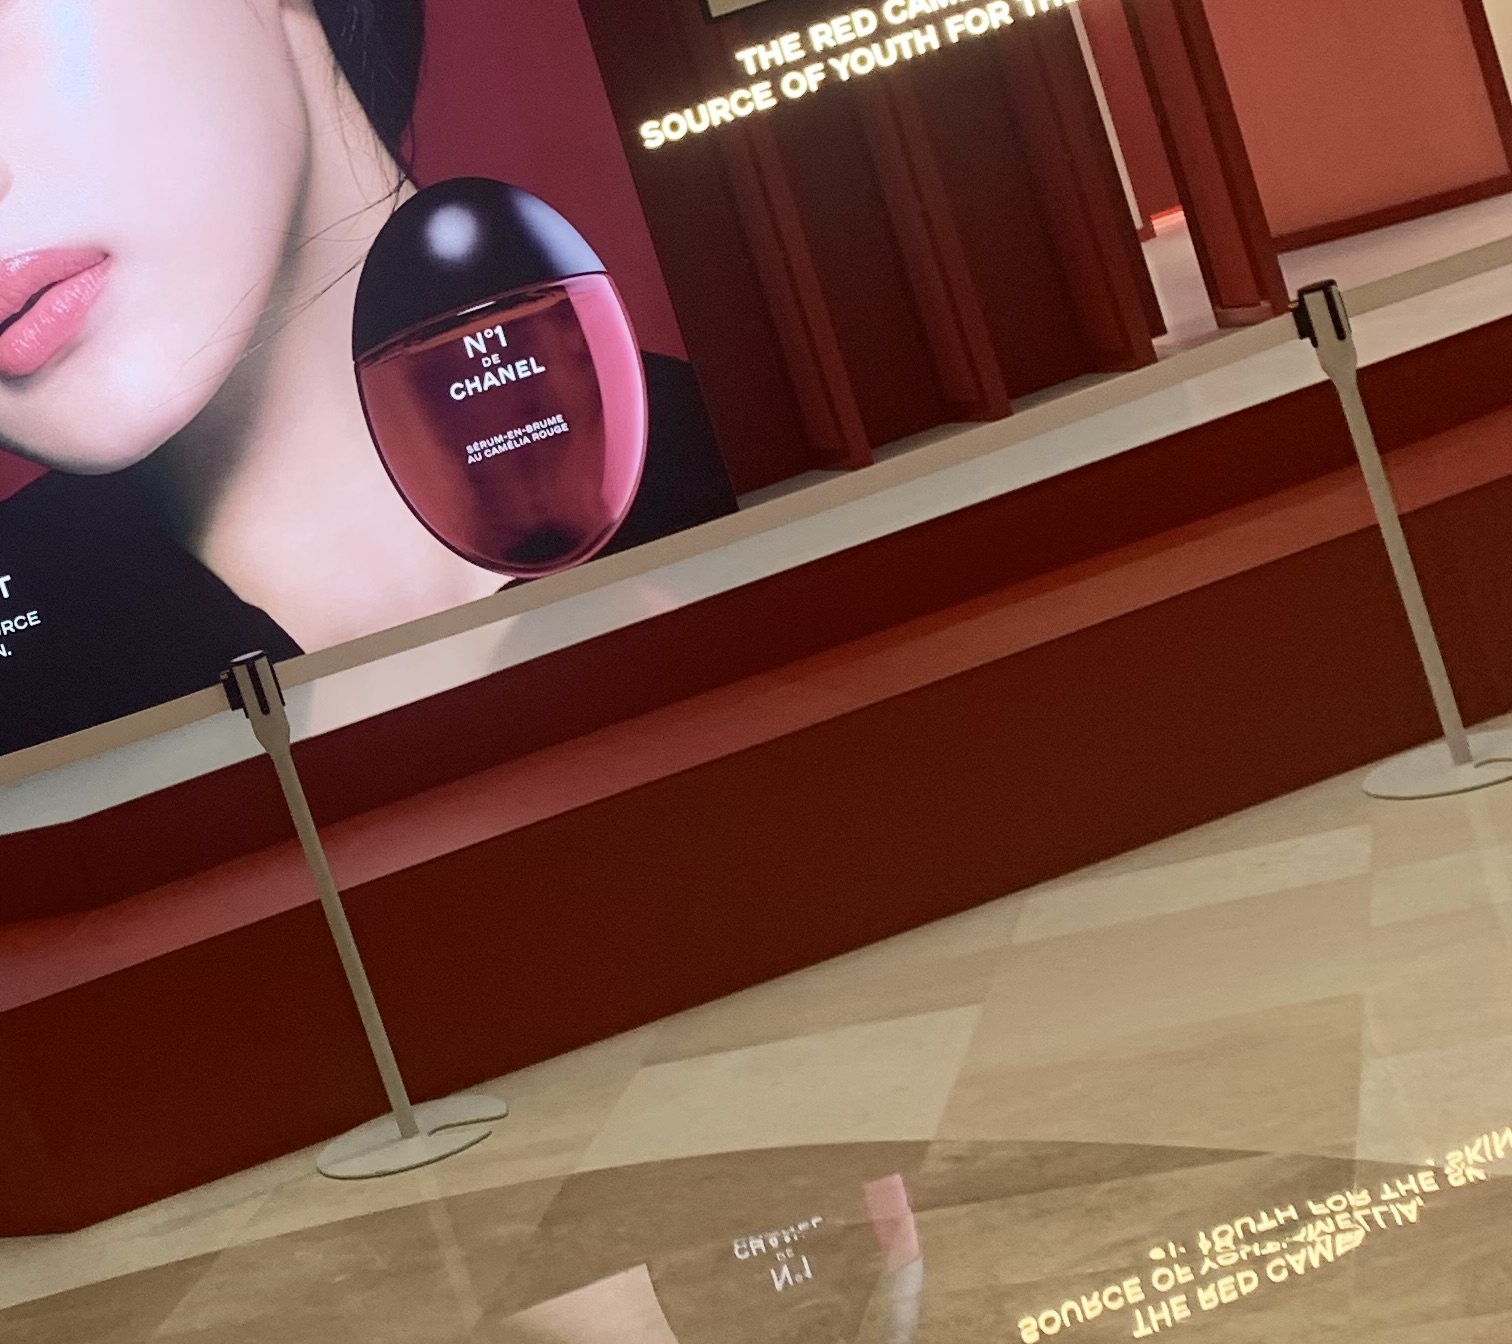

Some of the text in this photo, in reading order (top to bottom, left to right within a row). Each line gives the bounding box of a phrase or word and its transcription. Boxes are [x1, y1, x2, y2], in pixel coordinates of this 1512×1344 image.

[736, 32, 805, 76] THE
[811, 10, 878, 54] RED
[640, 82, 777, 150] SOURCE
[781, 62, 828, 101] OF
[829, 26, 940, 83] YOUTH
[946, 4, 1012, 45] FOR
[449, 356, 546, 401] CHANEL
[481, 353, 501, 368] DE
[466, 414, 564, 454] SÉRUM-EN-BRUME
[468, 423, 569, 465] AU CAMÉLIA ROUGE
